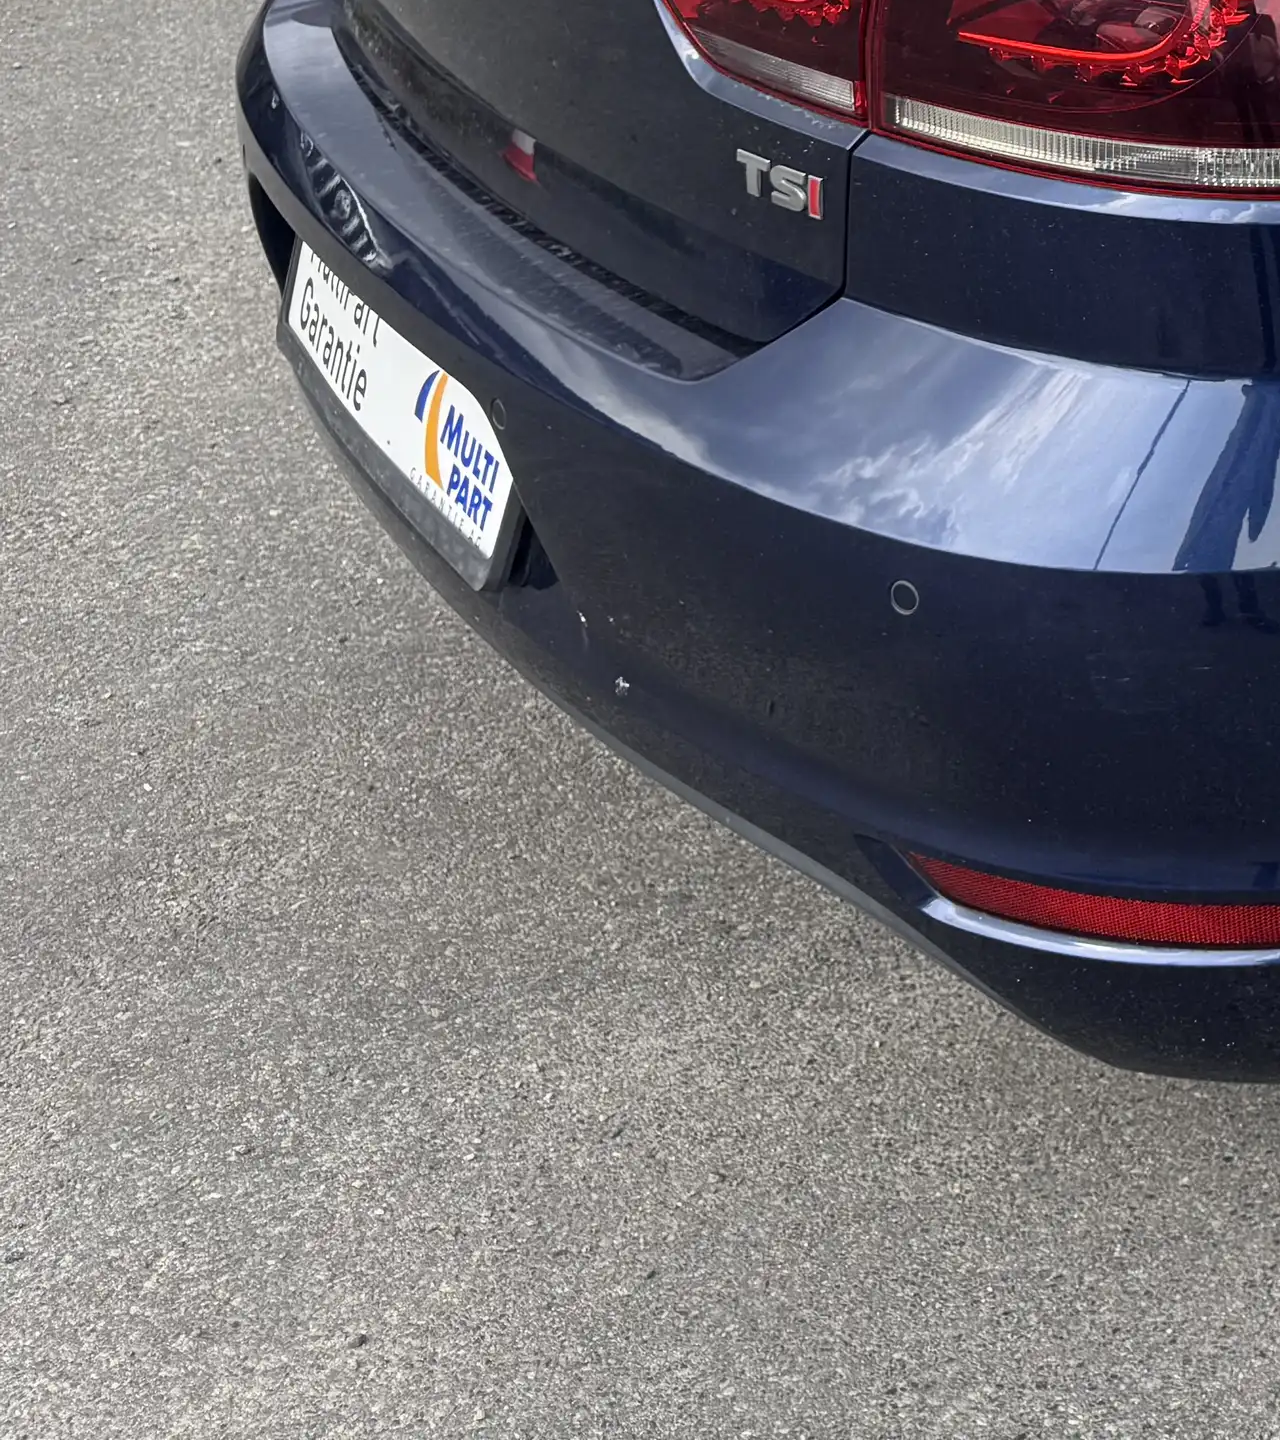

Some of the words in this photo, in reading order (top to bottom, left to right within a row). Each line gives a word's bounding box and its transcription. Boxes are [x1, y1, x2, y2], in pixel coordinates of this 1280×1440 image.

[736, 148, 824, 220] TSI
[300, 277, 368, 411] Garantie
[440, 404, 500, 494] MULTI
[446, 463, 494, 532] PART
